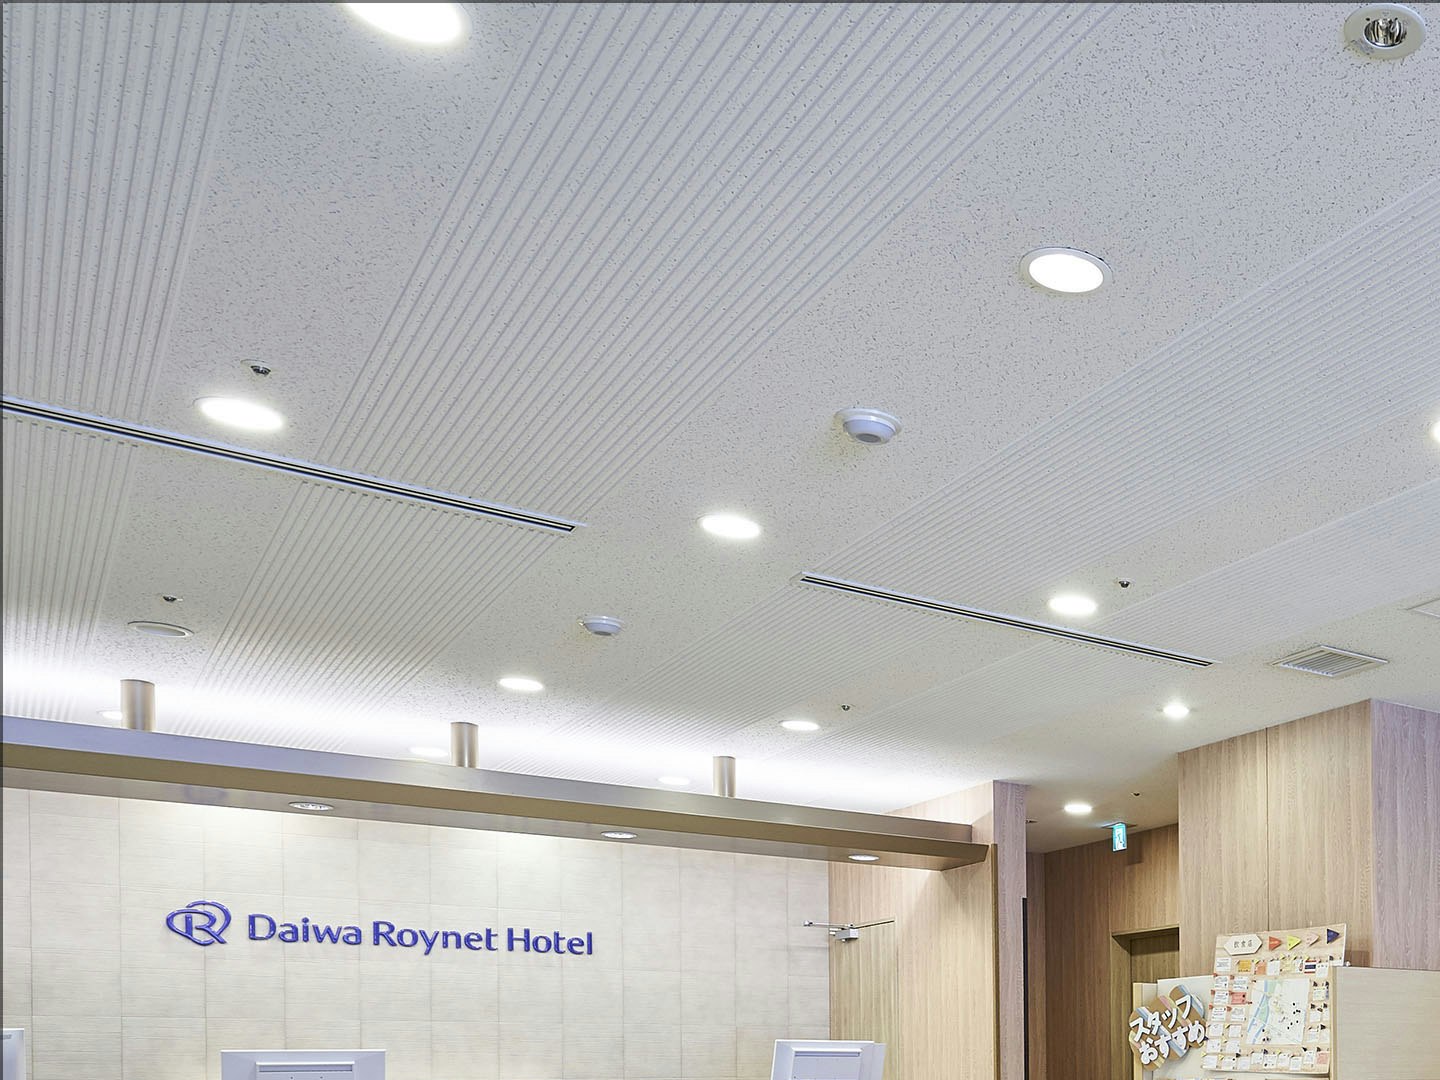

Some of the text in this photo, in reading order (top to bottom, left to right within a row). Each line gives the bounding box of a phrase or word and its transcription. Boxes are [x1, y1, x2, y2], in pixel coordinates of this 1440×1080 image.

[249, 914, 363, 945] Daiwa
[373, 920, 495, 955] Roynet
[507, 927, 593, 955] Hotel
[1129, 994, 1192, 1042] スタッフ
[1139, 1020, 1206, 1065] おすすめ
